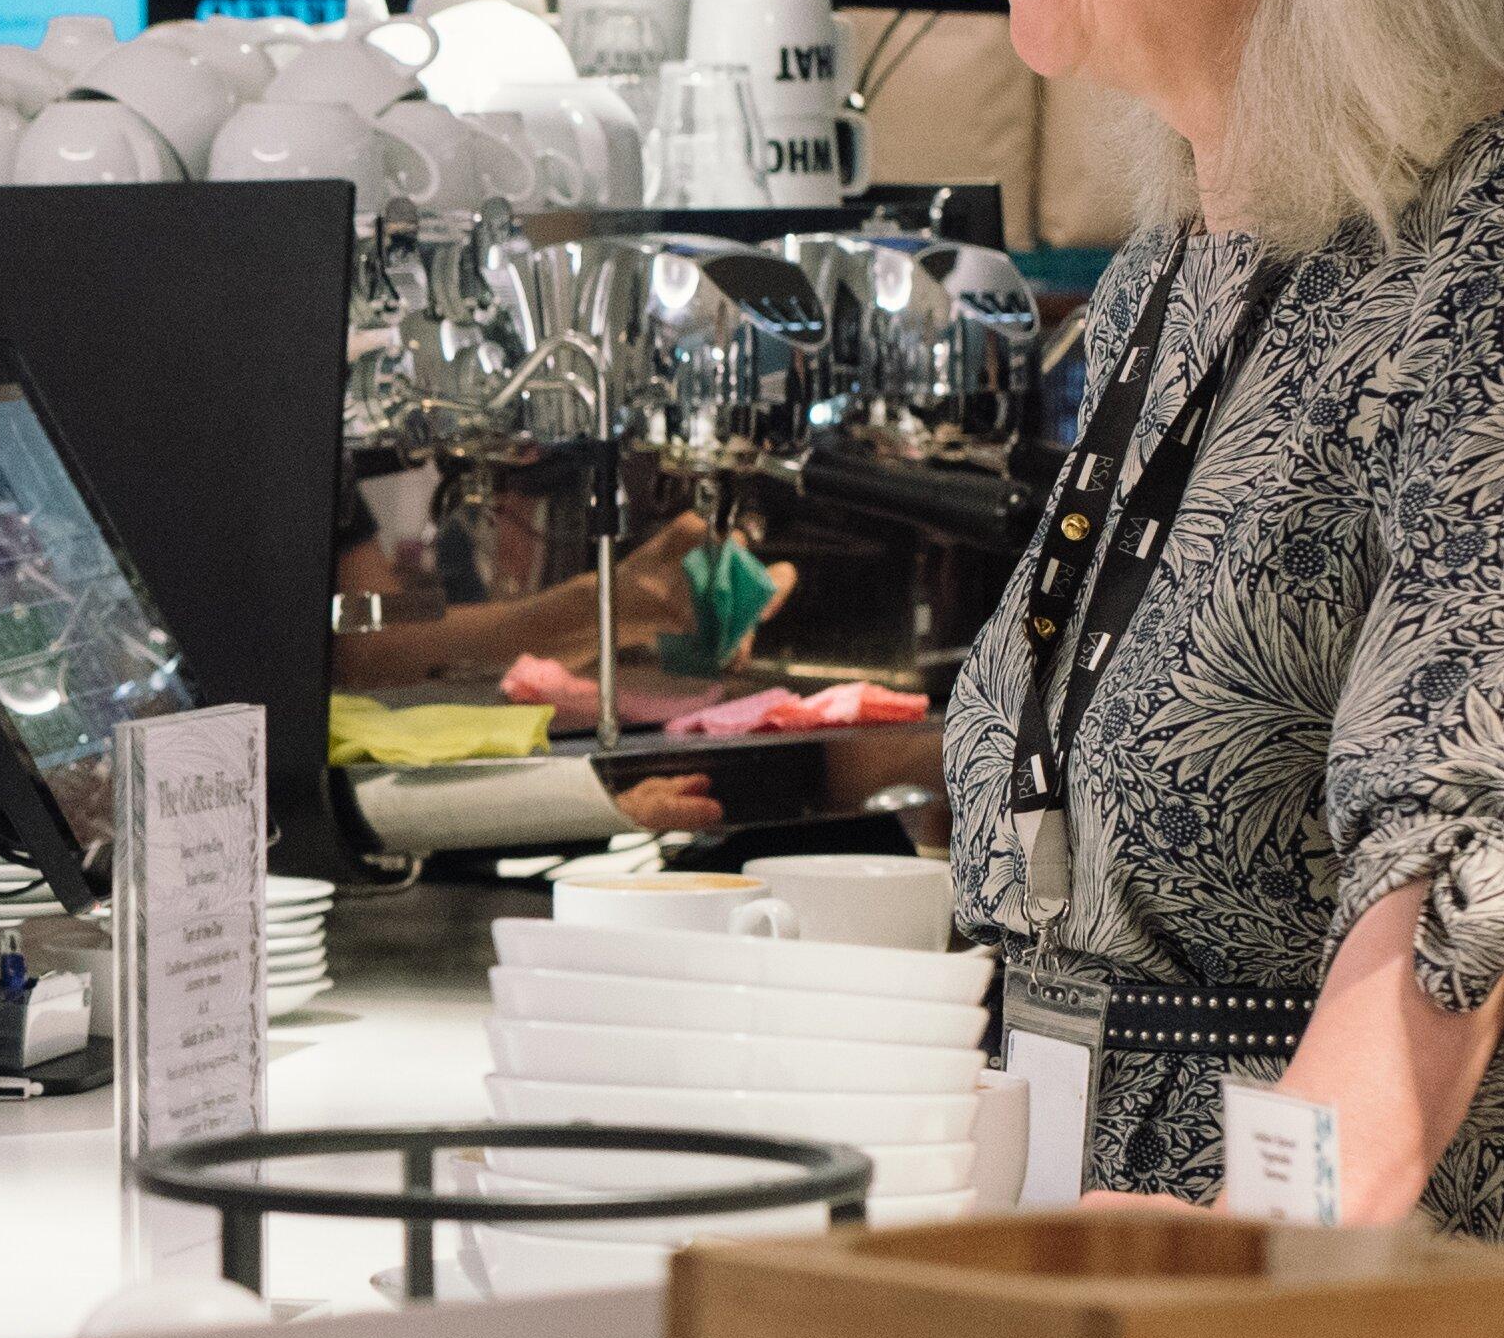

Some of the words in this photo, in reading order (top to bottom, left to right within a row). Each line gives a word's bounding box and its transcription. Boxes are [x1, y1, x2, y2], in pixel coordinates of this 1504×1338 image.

[1086, 455, 1114, 492] RSA
[1118, 517, 1152, 555] RSA
[1052, 562, 1077, 597] RSA
[1078, 631, 1104, 670] RSA
[1017, 757, 1036, 799] RSA
